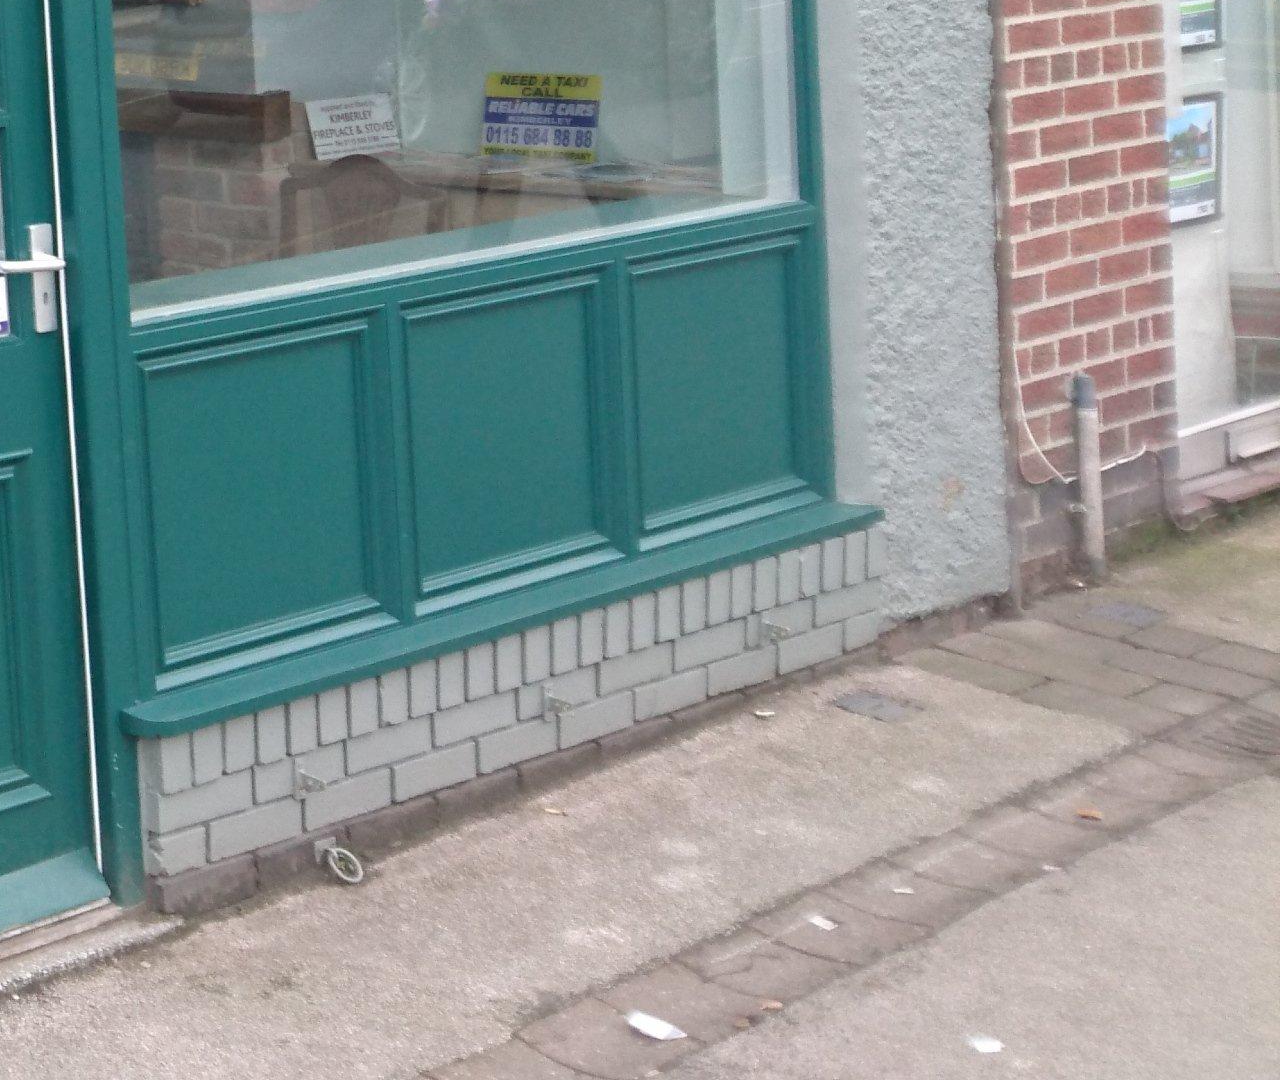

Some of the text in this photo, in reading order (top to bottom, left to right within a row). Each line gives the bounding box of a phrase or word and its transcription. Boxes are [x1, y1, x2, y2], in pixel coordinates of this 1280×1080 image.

[500, 75, 589, 87] NEED A TAXI
[521, 87, 563, 98] CALL
[329, 110, 373, 124] KIMBERLEY
[556, 104, 596, 117] CARS
[313, 120, 396, 139] FIREPLACE & STOVES
[485, 126, 519, 144] 0115
